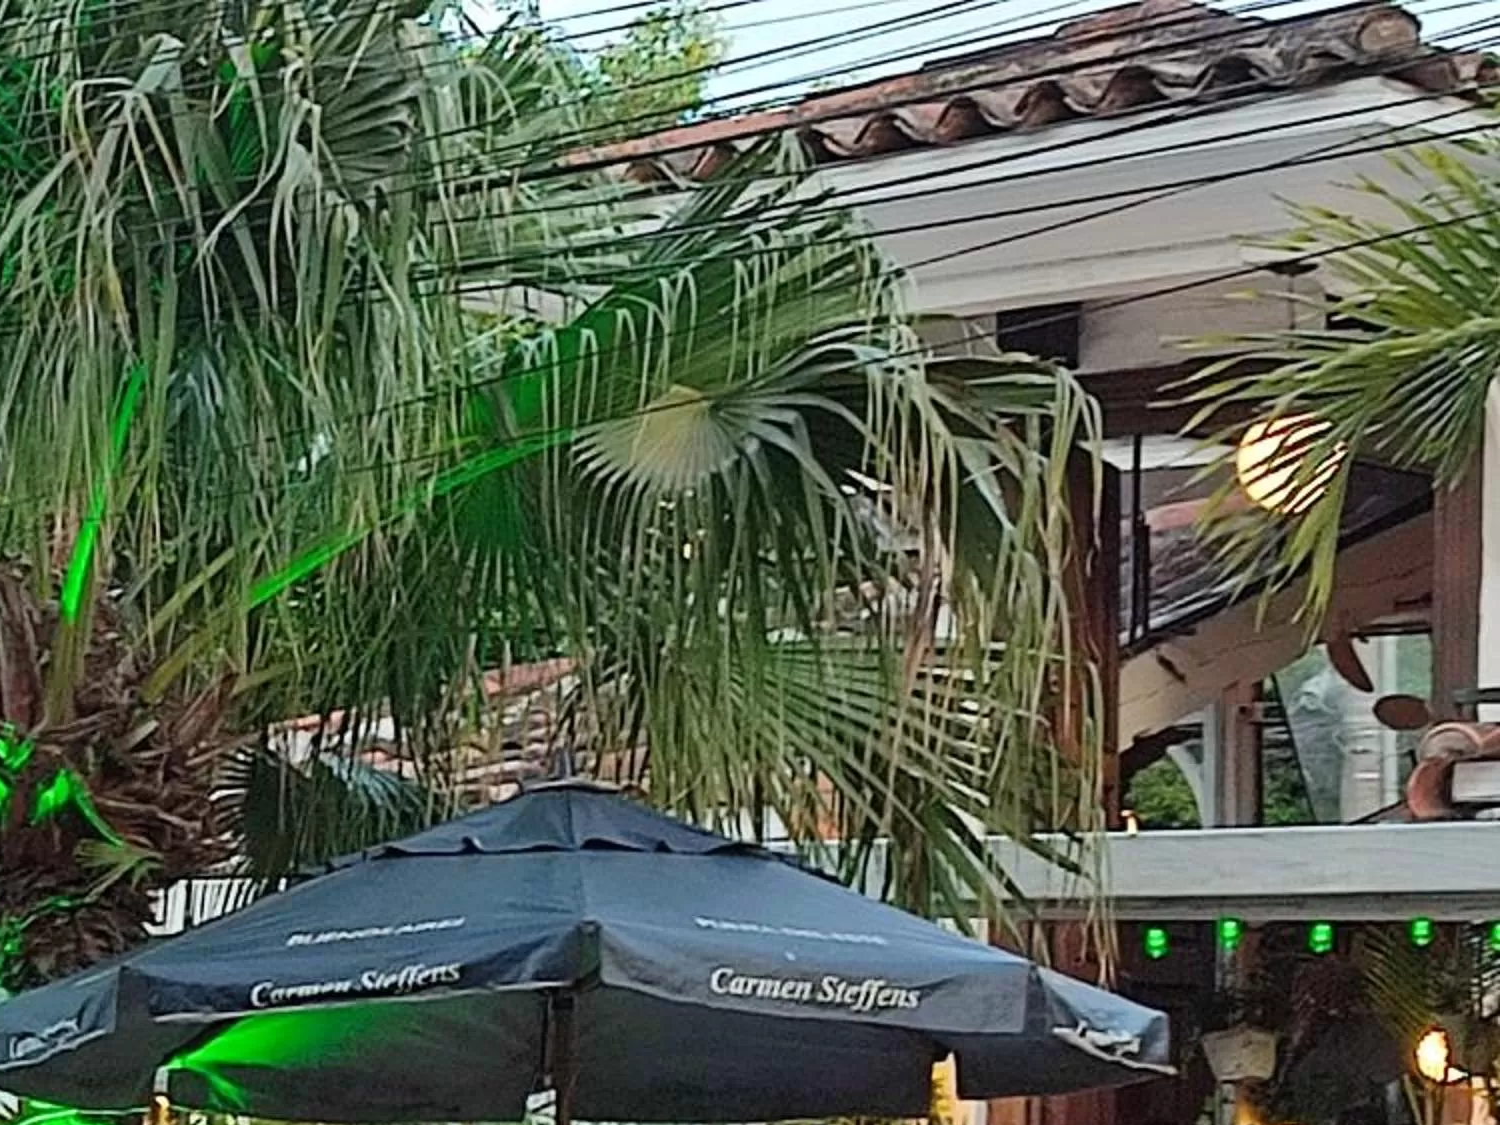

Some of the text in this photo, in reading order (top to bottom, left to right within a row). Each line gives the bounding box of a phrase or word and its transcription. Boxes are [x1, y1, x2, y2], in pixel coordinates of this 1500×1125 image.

[250, 962, 464, 1008] Carmen Steffens
[710, 967, 921, 1012] Carmen Steffens
